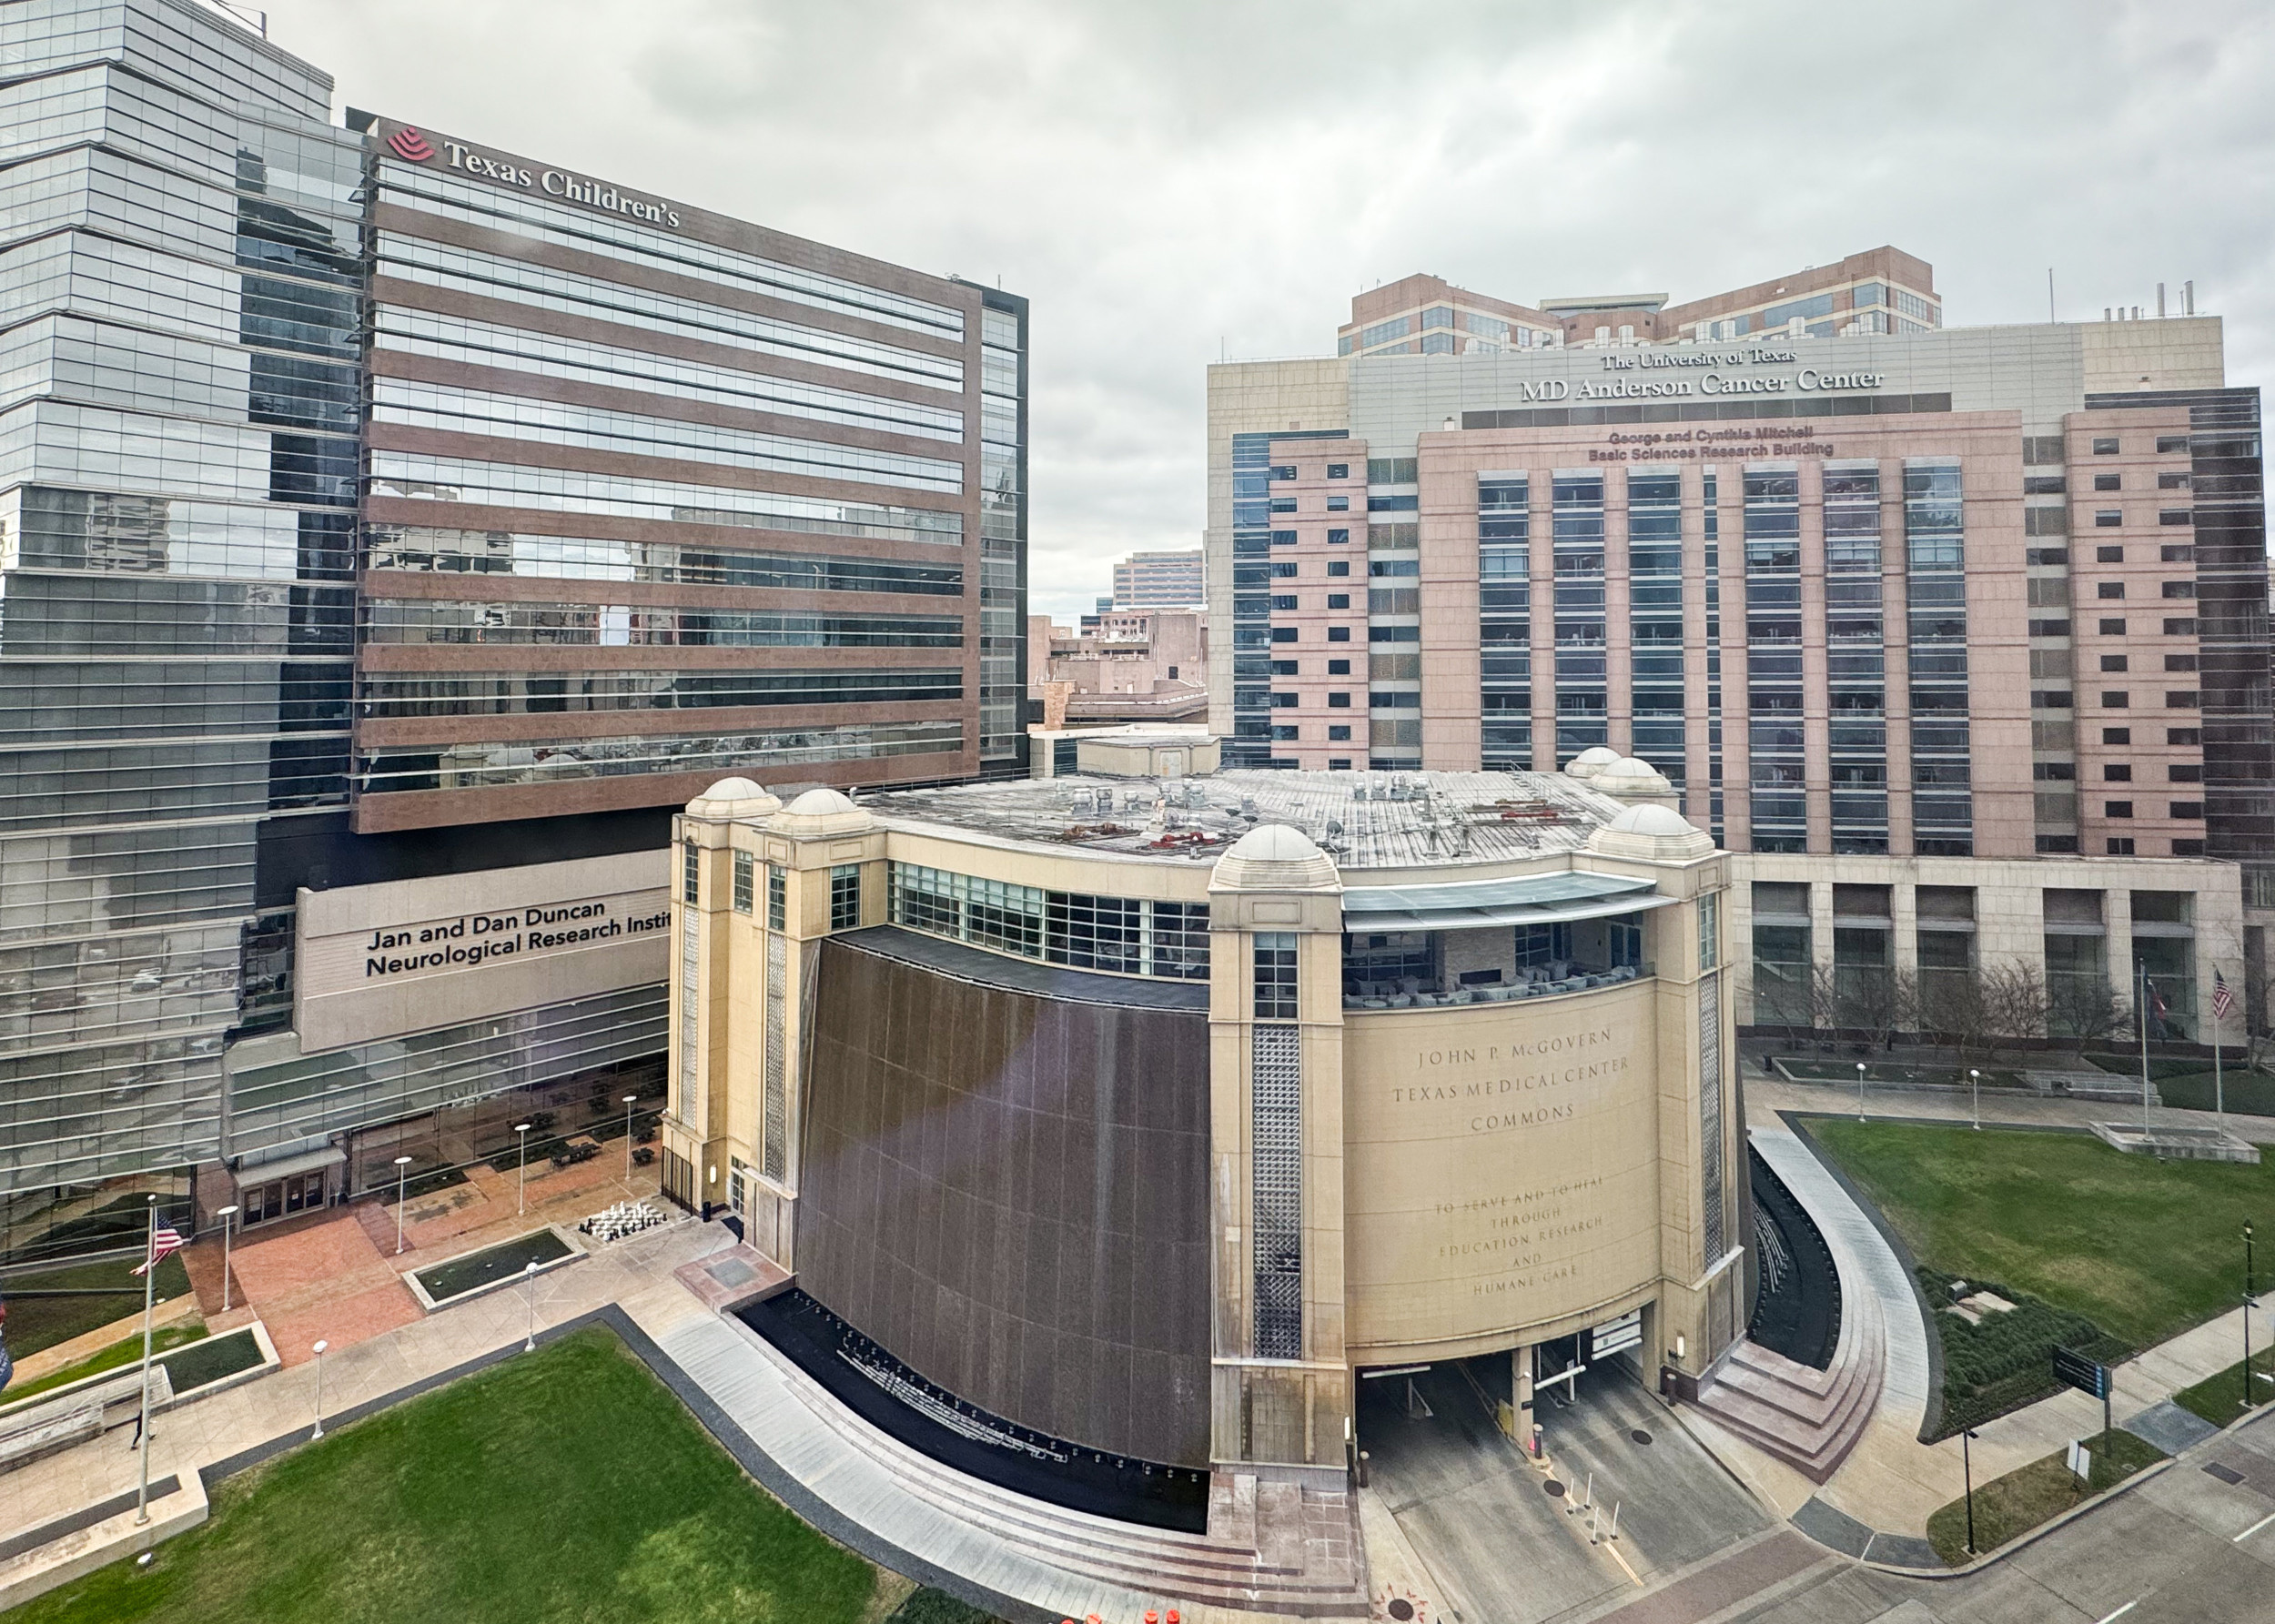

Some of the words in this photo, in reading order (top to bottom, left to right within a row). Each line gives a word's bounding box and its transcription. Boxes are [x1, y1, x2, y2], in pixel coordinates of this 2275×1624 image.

[444, 140, 532, 187] Texas
[541, 170, 680, 227] Children's
[1602, 354, 1634, 370] The
[1638, 351, 1722, 370] University
[1727, 349, 1744, 365] of
[1751, 348, 1798, 363] Texas
[1522, 379, 1570, 402] MD
[1575, 375, 1693, 400] Anderson
[1701, 371, 1791, 395] Cancer
[1796, 368, 1886, 392] Center
[1609, 432, 1662, 446] George
[1665, 429, 1693, 442] and
[1695, 429, 1752, 444] Cynthia
[1755, 425, 1815, 439] Mitchell
[1589, 449, 1627, 461] Basic
[1631, 446, 1696, 460] Sciences
[1700, 444, 1769, 458] Research
[1774, 440, 1835, 457] Building
[367, 931, 411, 952] Jan
[419, 917, 465, 943] and
[472, 914, 518, 935] Dan
[525, 903, 605, 927] Duncan
[366, 933, 521, 978] Neurological
[529, 919, 622, 951] Research
[1418, 1047, 1476, 1069] JOHN
[1393, 1084, 1458, 1103] TEXAS
[1466, 1072, 1558, 1097] MEDICAL
[1564, 1056, 1629, 1083] CENTER
[1471, 1103, 1574, 1132] COMMONS
[1435, 1203, 1455, 1215] TO
[1514, 1190, 1545, 1205] AND
[1491, 1207, 1562, 1229] THROUGH
[1539, 1215, 1603, 1243] RESEARCH
[1512, 1253, 1542, 1268] AND
[1473, 1276, 1536, 1296] HUMANE
[1543, 1265, 1578, 1284] CARE
